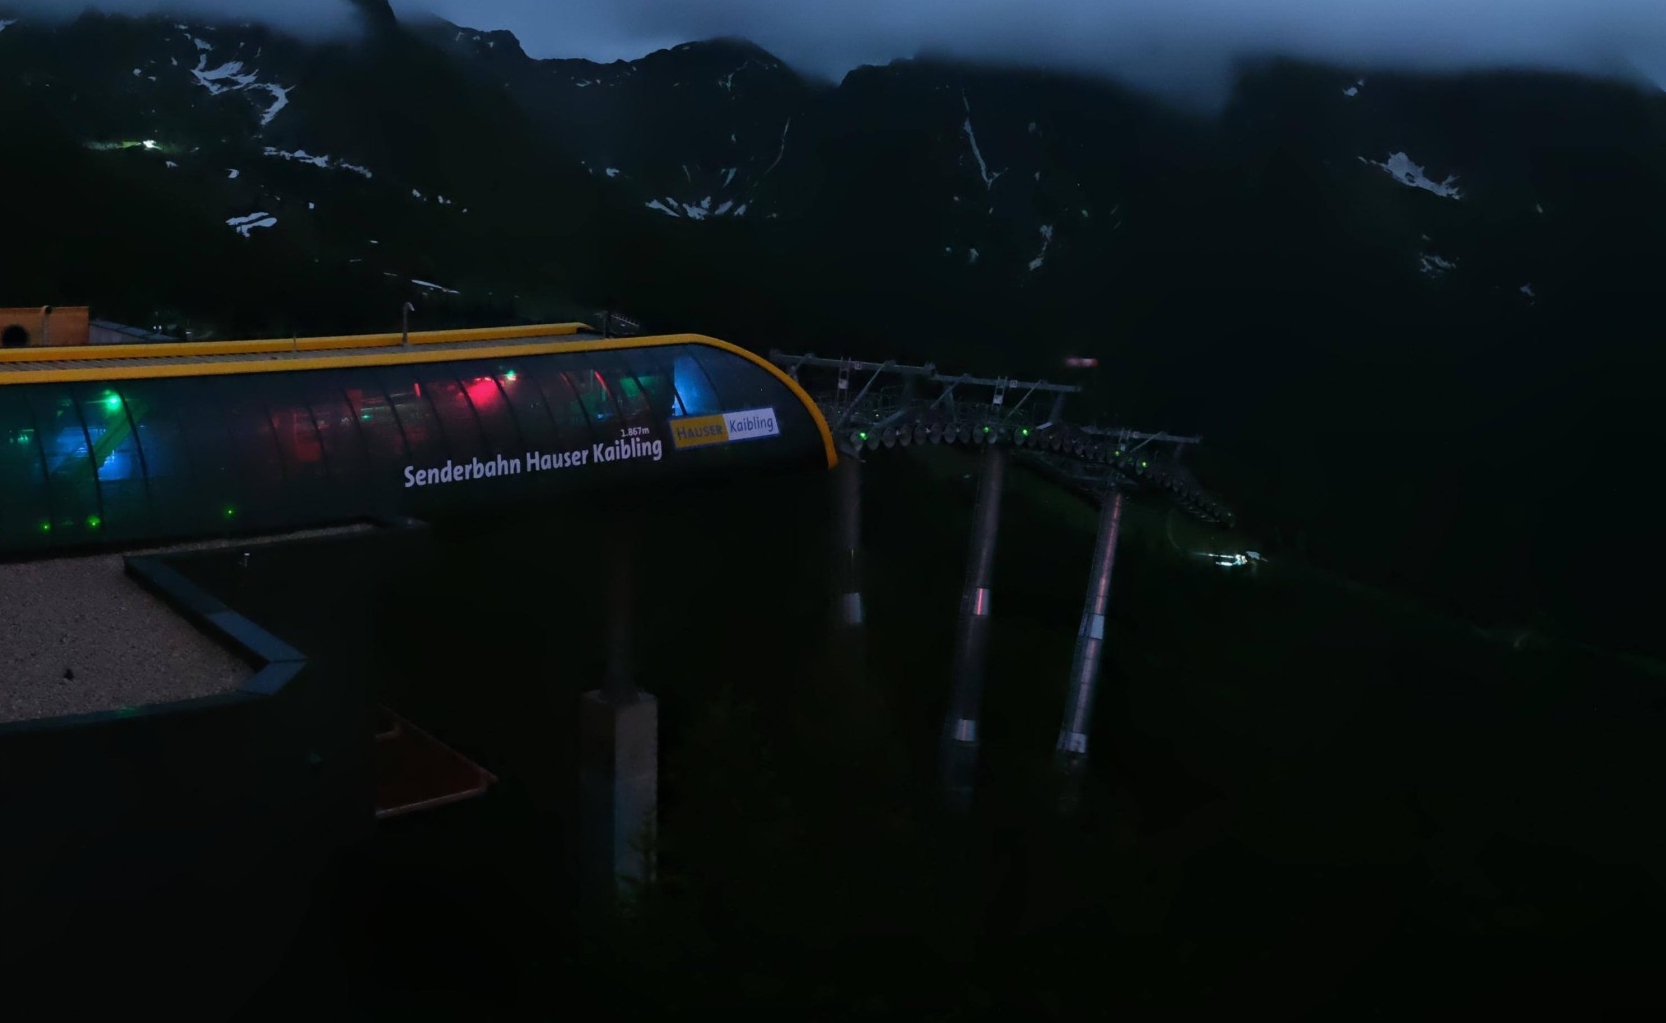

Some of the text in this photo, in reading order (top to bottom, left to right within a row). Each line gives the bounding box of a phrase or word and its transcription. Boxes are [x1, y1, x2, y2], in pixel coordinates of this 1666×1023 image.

[621, 427, 650, 437] 1.867m
[677, 417, 774, 440] HAUSER Kaibling
[404, 437, 663, 488] Senderbahn Hauser Kaibling
